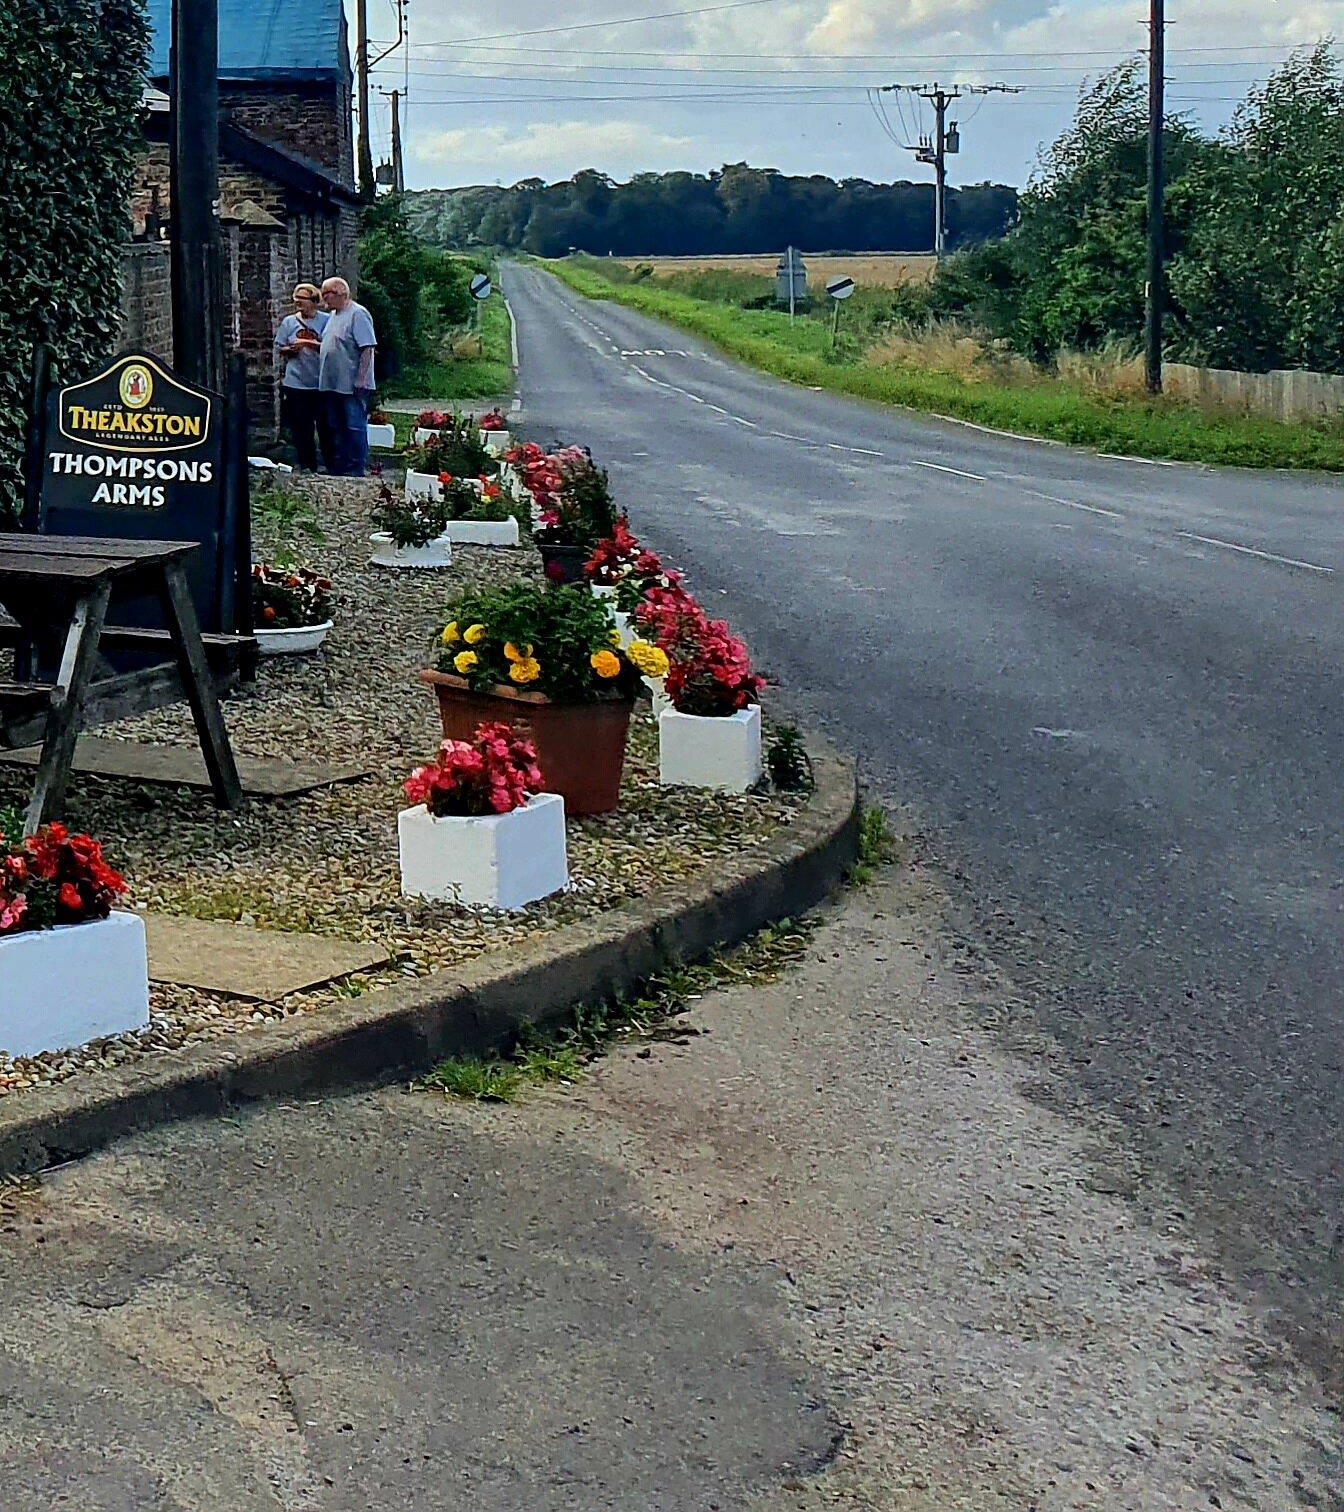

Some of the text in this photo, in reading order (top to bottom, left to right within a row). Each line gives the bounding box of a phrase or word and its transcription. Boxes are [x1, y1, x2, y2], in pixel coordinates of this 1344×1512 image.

[68, 405, 200, 436] THEAKSTON
[49, 452, 213, 482] THOMPSONS
[91, 482, 165, 507] ARMS
